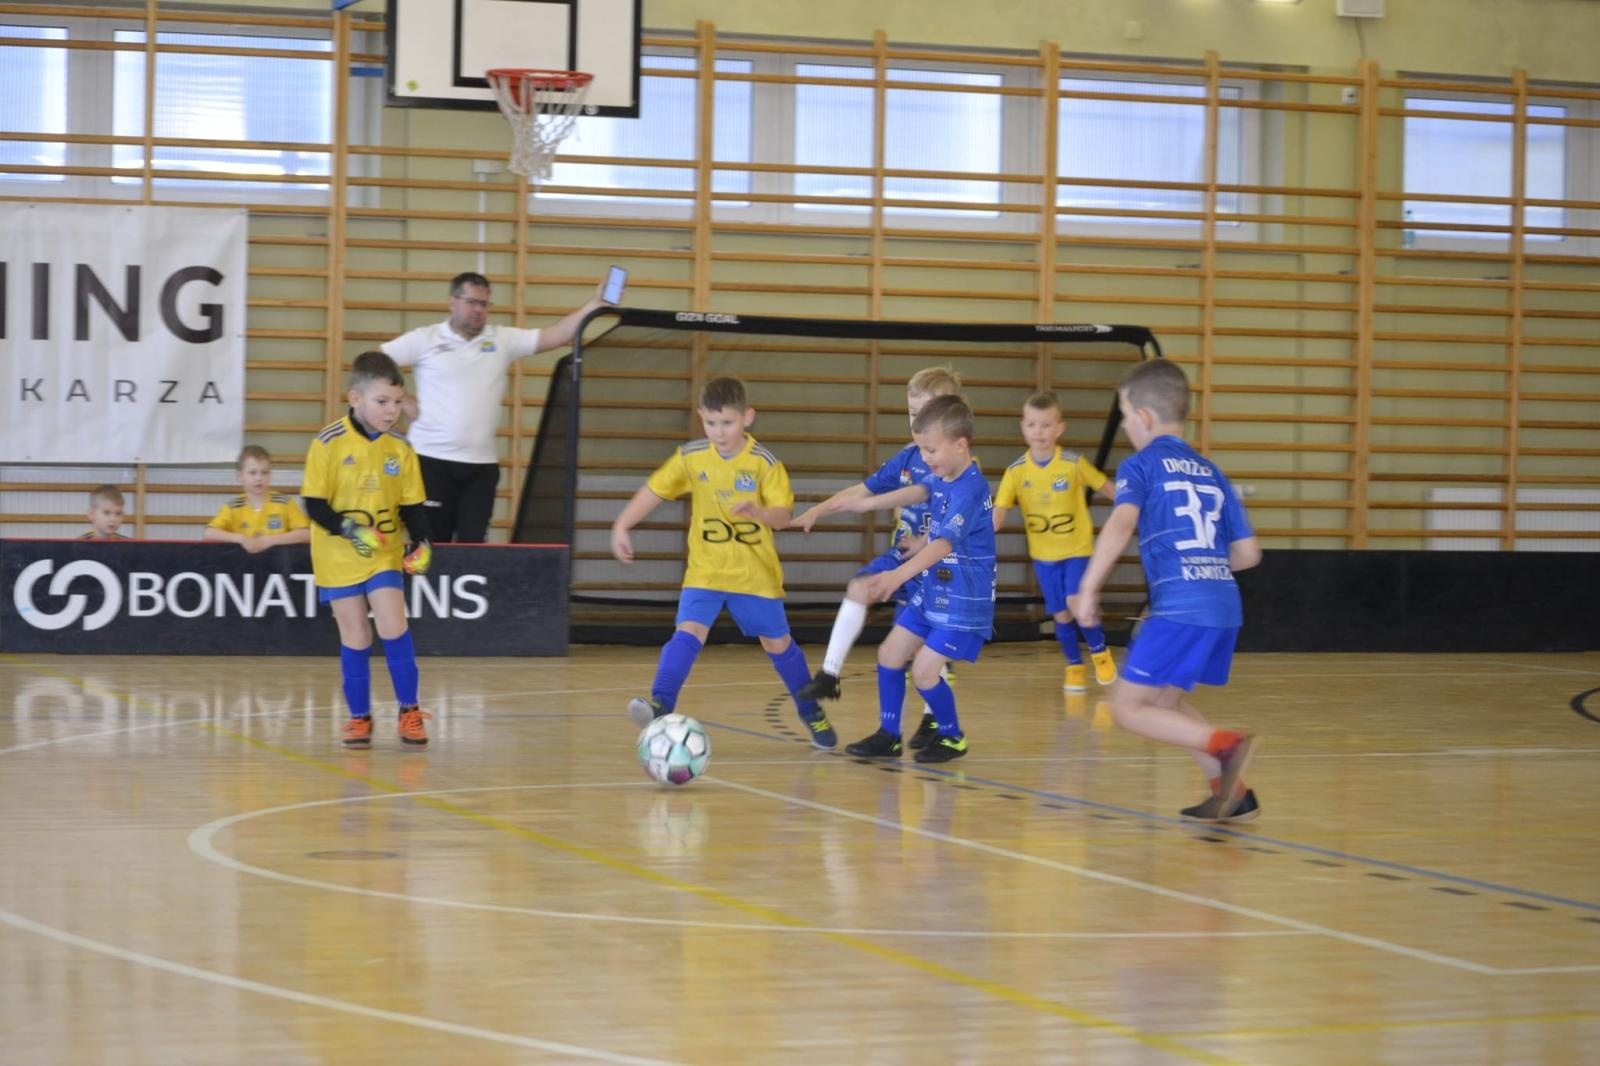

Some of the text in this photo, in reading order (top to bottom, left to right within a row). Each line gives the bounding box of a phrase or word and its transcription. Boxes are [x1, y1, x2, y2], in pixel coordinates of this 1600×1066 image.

[0, 261, 225, 344] ING
[20, 377, 224, 404] KARZA
[127, 571, 490, 620] BONATNS
